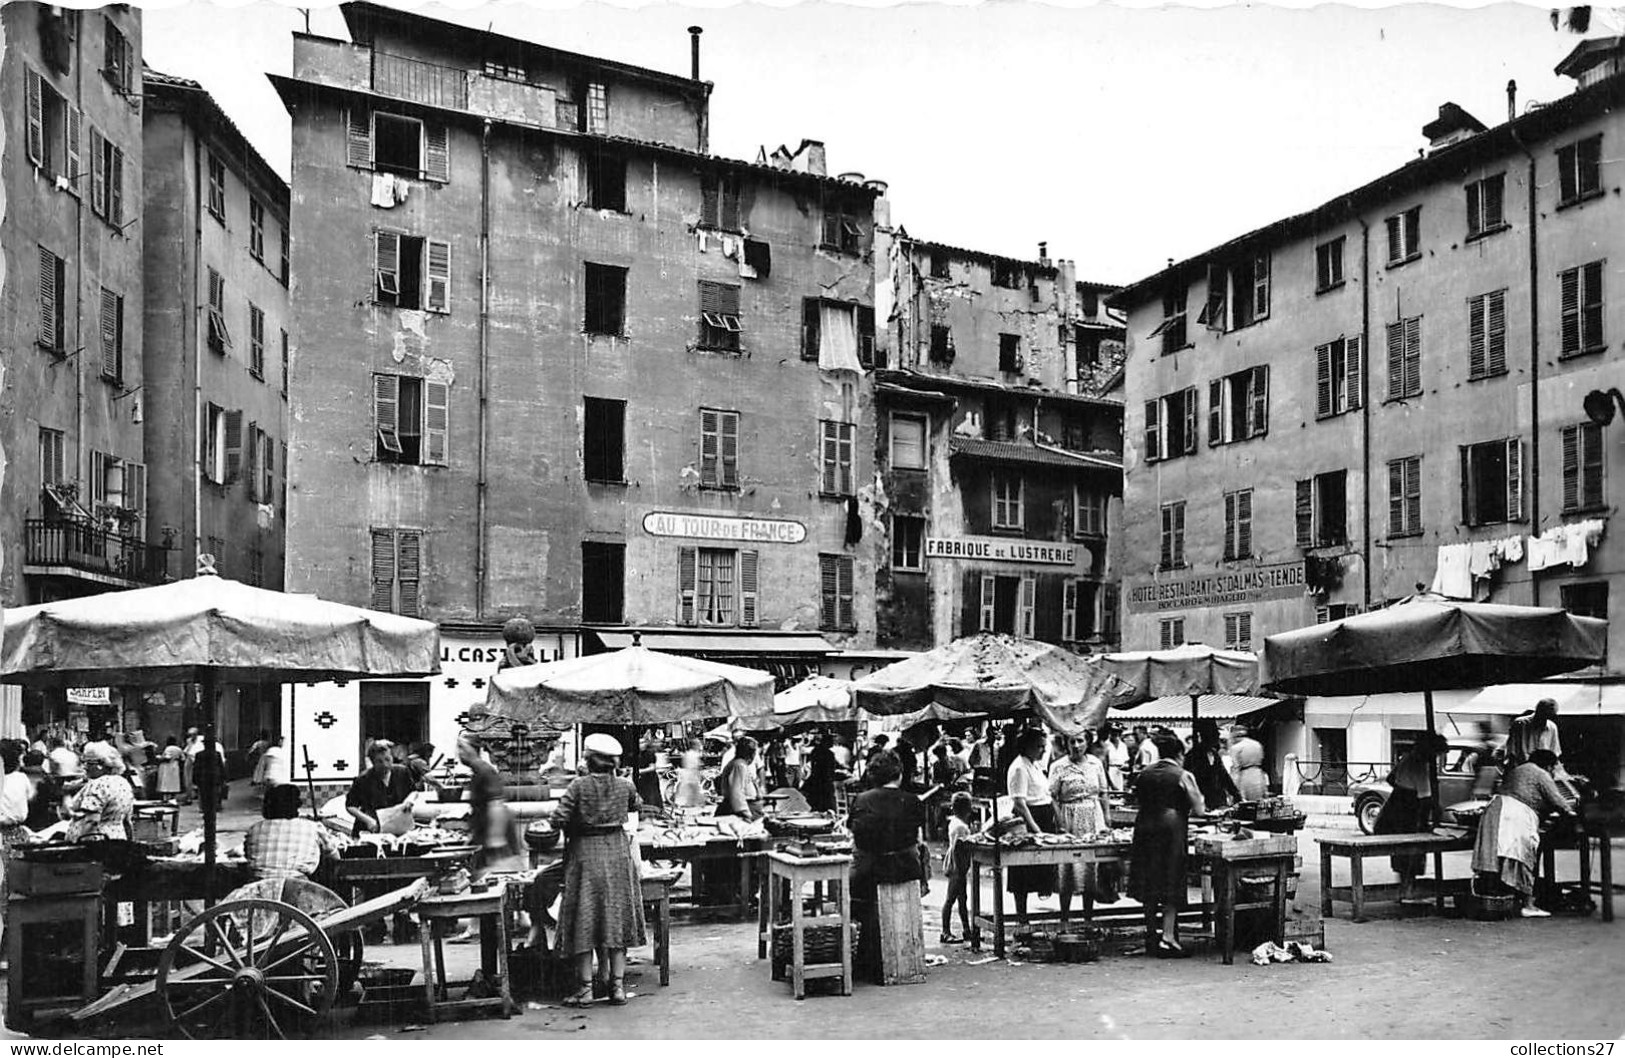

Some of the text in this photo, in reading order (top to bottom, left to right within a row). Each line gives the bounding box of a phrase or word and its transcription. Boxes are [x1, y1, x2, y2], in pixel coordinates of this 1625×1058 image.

[656, 516, 675, 534] AU
[683, 519, 720, 537] TOUR
[741, 521, 794, 540] FRANCE
[929, 540, 990, 557] FABRIQUE
[1010, 545, 1073, 562] LUSTRERIE
[1269, 566, 1303, 587] TENDE
